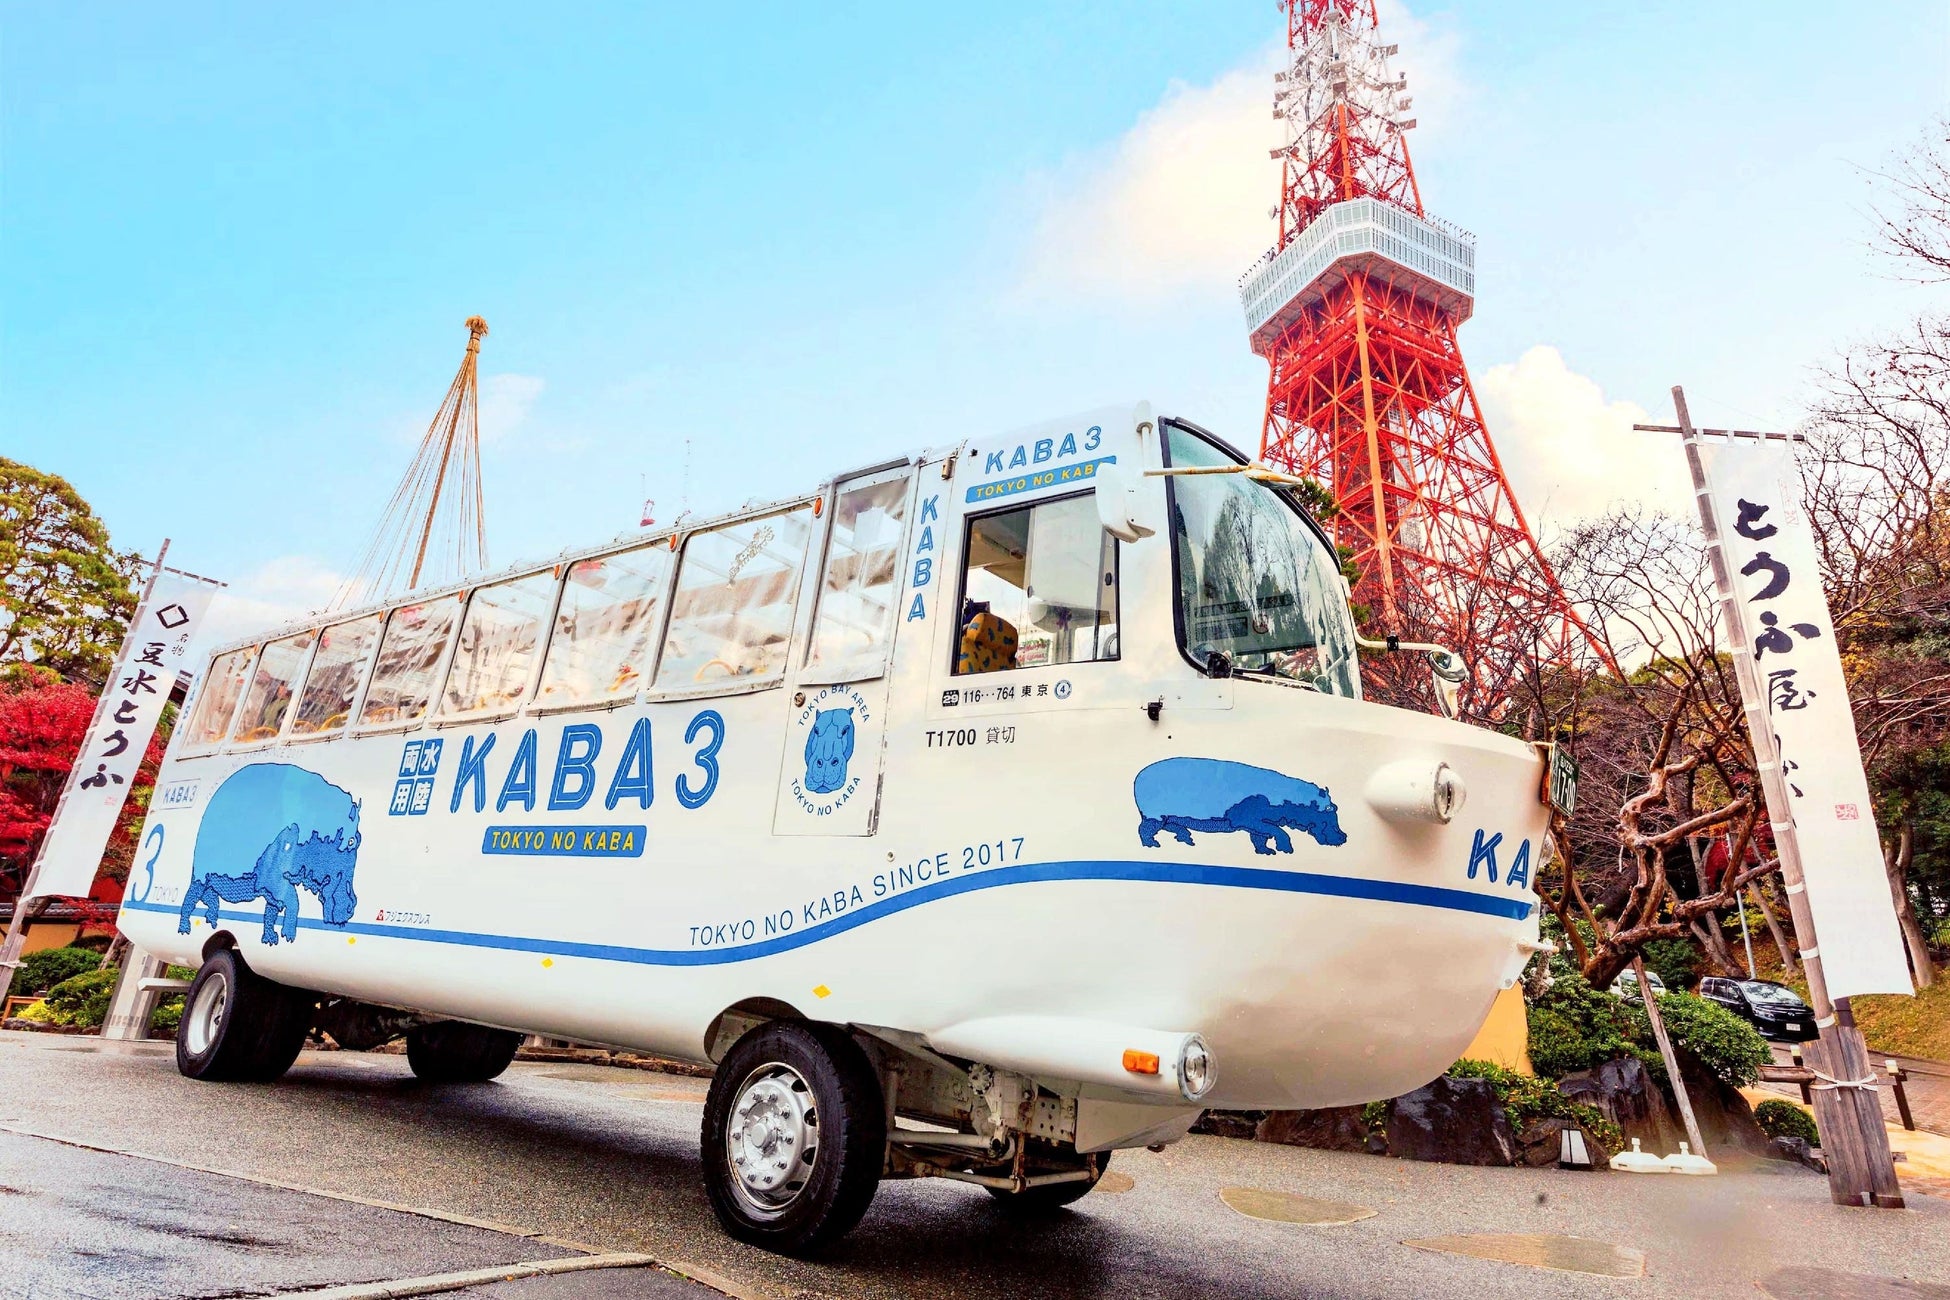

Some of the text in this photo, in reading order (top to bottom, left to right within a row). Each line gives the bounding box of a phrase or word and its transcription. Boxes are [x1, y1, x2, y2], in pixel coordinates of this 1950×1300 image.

[976, 461, 1102, 498] TOKYO NO KAB
[907, 494, 939, 622] KABA
[798, 684, 870, 726] TOKYO BAY AREA
[1021, 684, 1048, 697] 東京
[925, 726, 1016, 748] T1700 貸切
[791, 777, 861, 816] TOKYO NO KABA
[492, 831, 634, 851] TOKYO NO KABA
[131, 824, 165, 902] 3
[690, 838, 1024, 946] TOKYO NO KABA SINCE 2017
